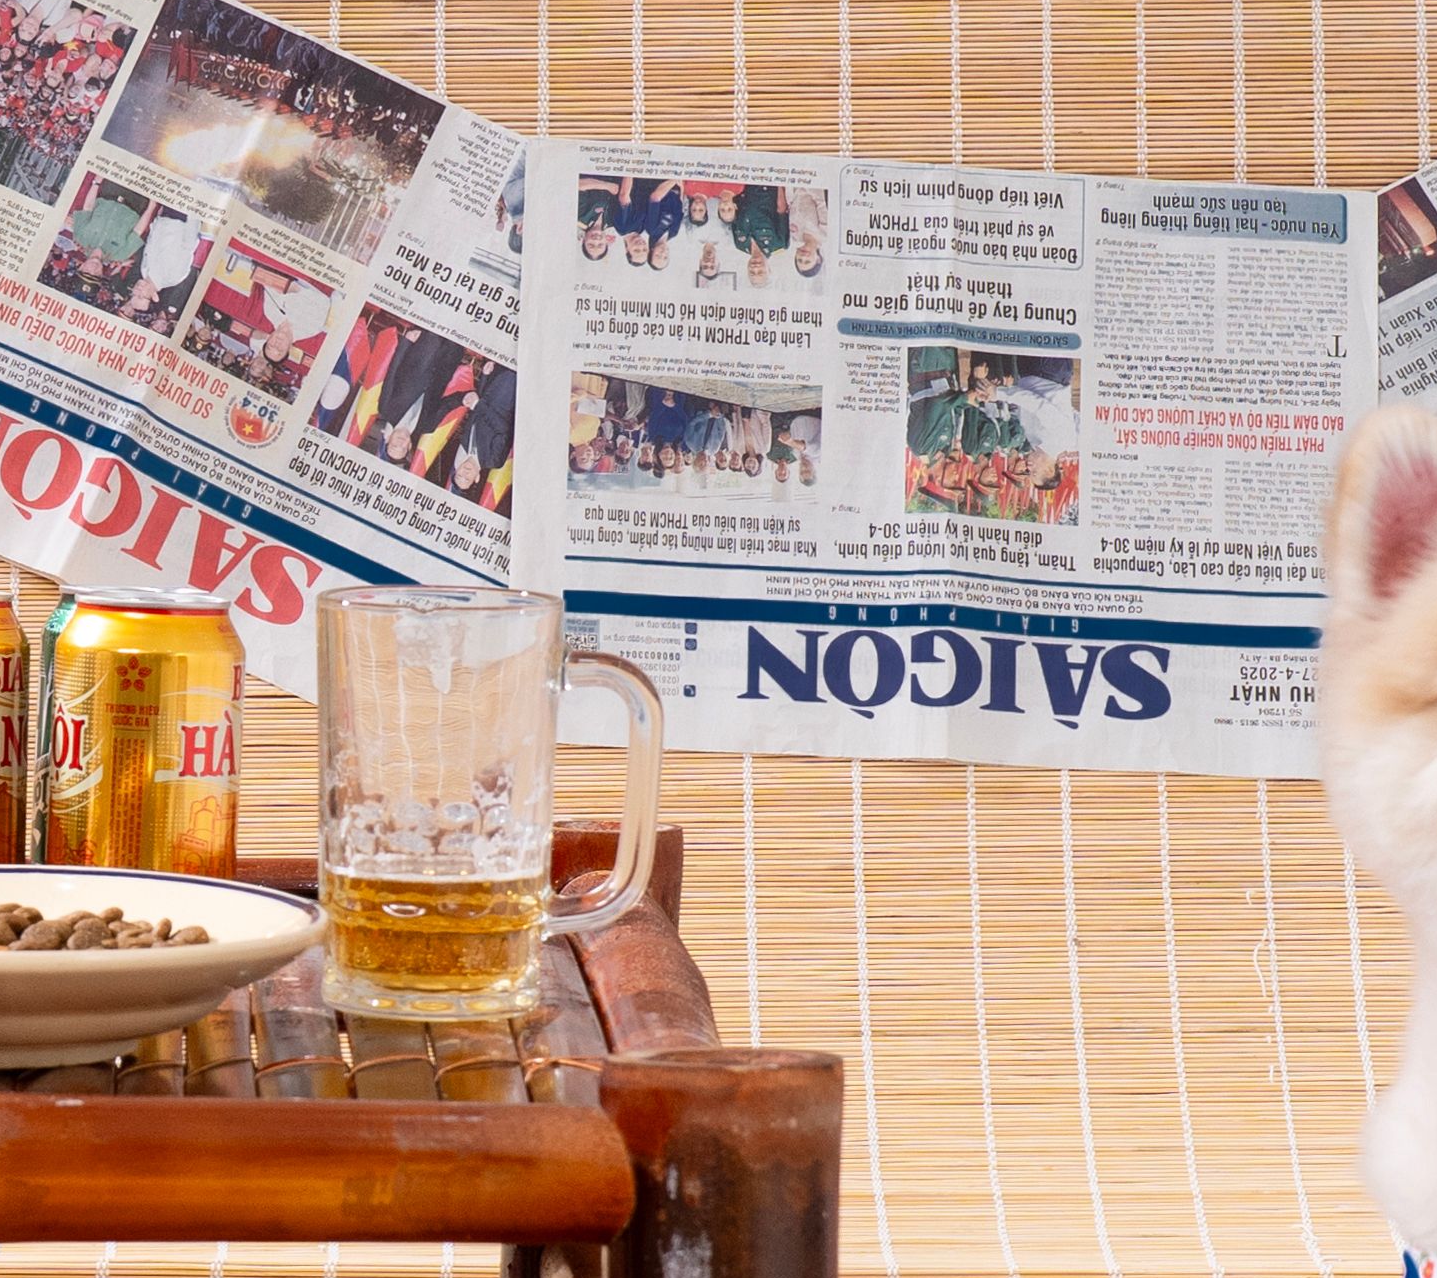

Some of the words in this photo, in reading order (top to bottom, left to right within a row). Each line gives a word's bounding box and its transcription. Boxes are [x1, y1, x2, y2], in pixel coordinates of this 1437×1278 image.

[843, 293, 867, 308] mơ
[874, 294, 908, 315] giấc
[916, 294, 962, 314] những
[968, 302, 987, 322] để
[993, 301, 1018, 321] tay
[1024, 303, 1076, 325] Chung
[1230, 682, 1280, 701] NHẬT
[1290, 686, 1314, 707] HỦ
[178, 711, 236, 777] HÀ
